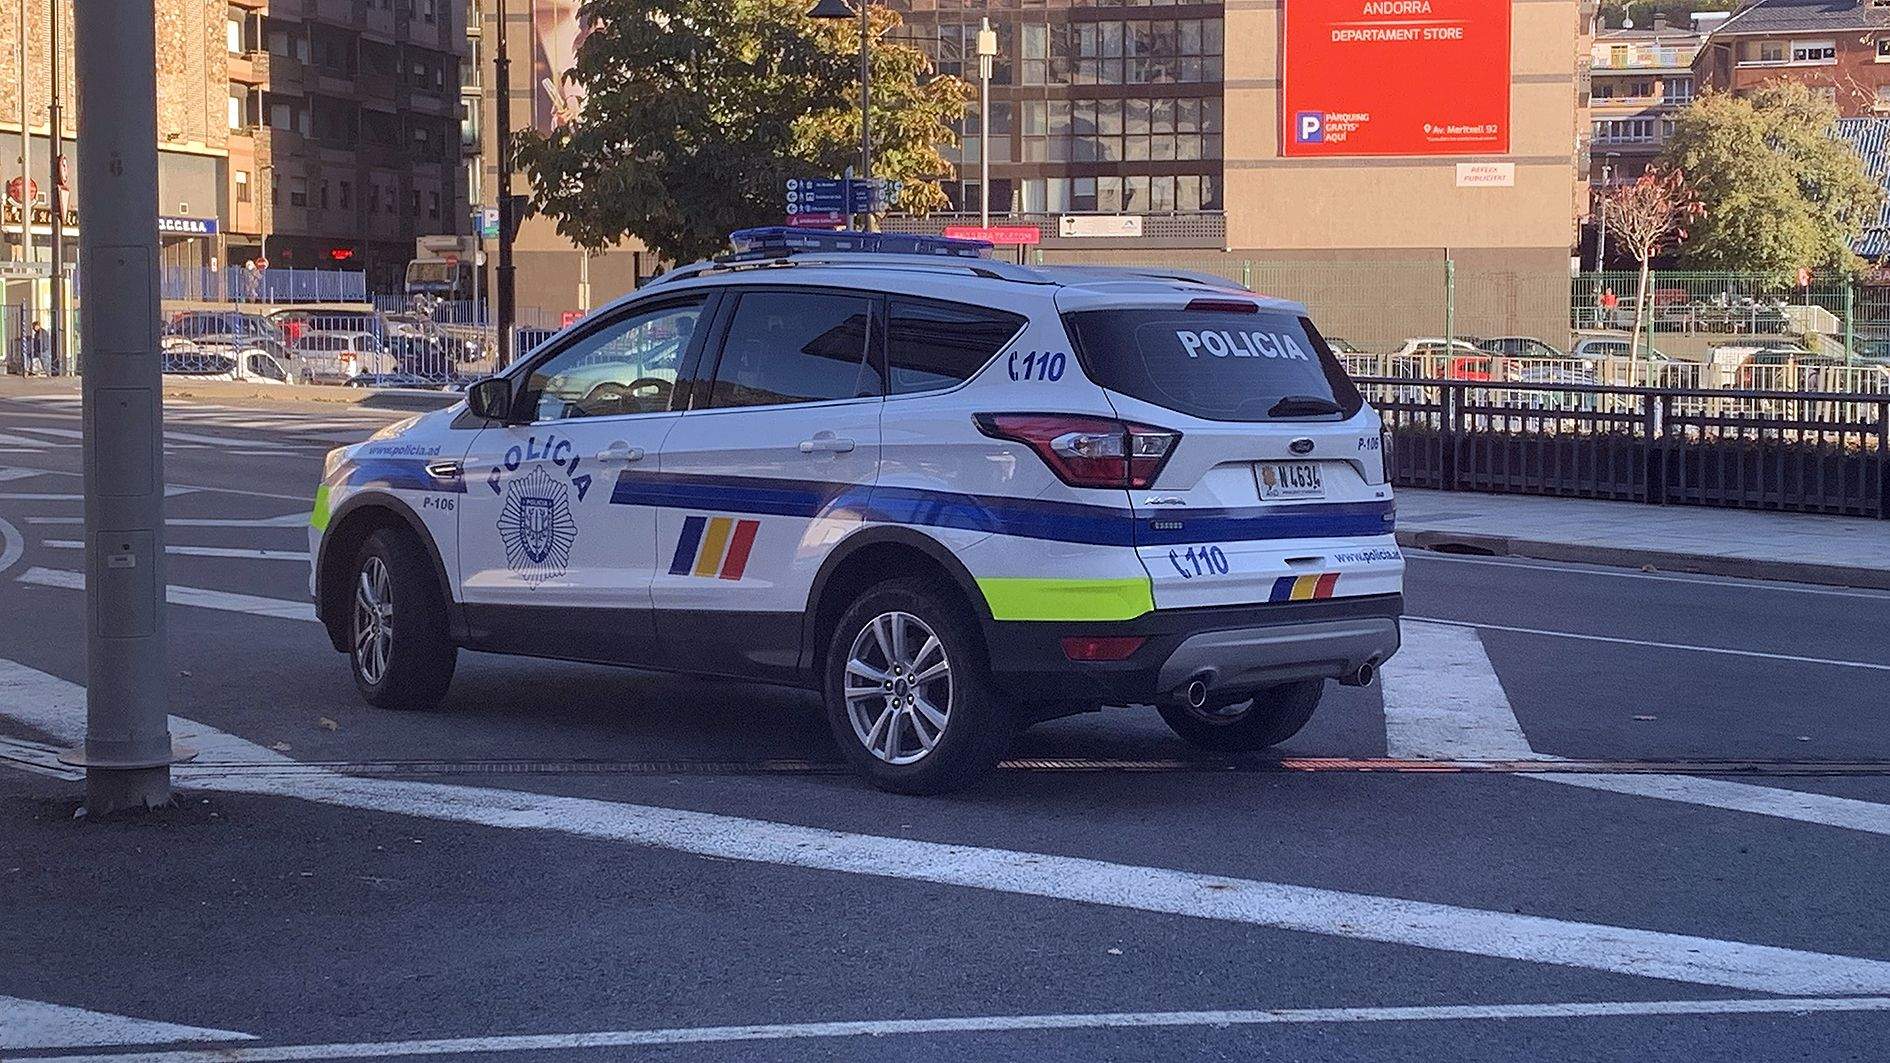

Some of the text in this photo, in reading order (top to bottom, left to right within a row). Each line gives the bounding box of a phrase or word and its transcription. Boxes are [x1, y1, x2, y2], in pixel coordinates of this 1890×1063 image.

[1363, 1, 1432, 14] ANDORRA
[1331, 27, 1464, 41] DEPARTAMENT STORE
[1302, 116, 1320, 140] P
[1176, 330, 1310, 362] POLICIA
[1023, 350, 1066, 382] 110
[368, 445, 442, 457] www.policia.ad
[486, 434, 593, 503] POLICIA
[423, 497, 456, 511] P-106
[1185, 545, 1229, 577] 110
[1334, 548, 1401, 564] www.policia.a
